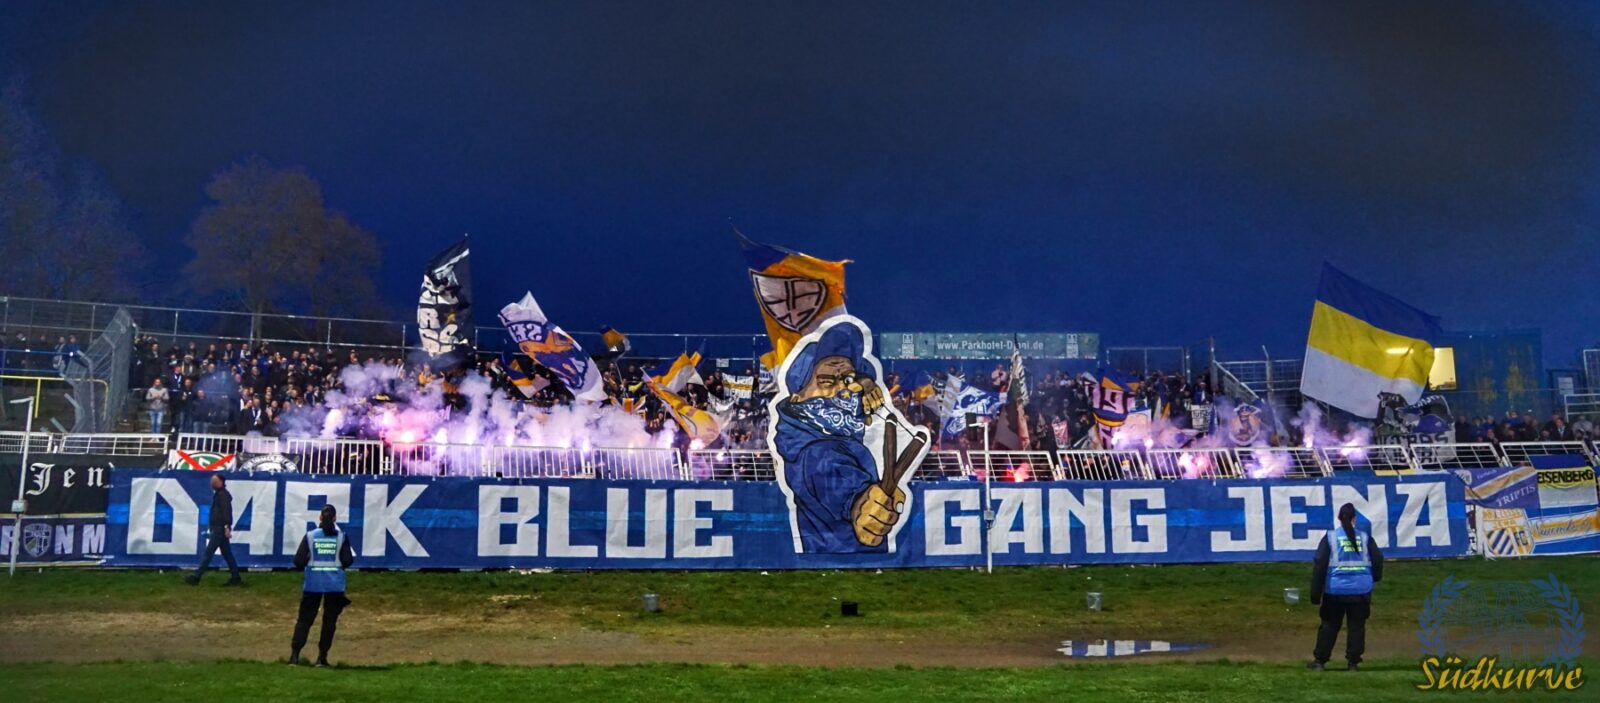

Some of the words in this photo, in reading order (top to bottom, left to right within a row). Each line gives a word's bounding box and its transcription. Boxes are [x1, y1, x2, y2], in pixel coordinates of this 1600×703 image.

[1536, 469, 1594, 483] EISENBERG
[1495, 485, 1536, 507] TRIPTIS
[126, 476, 430, 557] DARK
[477, 484, 734, 559] BLUE
[923, 487, 1168, 556] GANG
[1210, 481, 1451, 552] JENA
